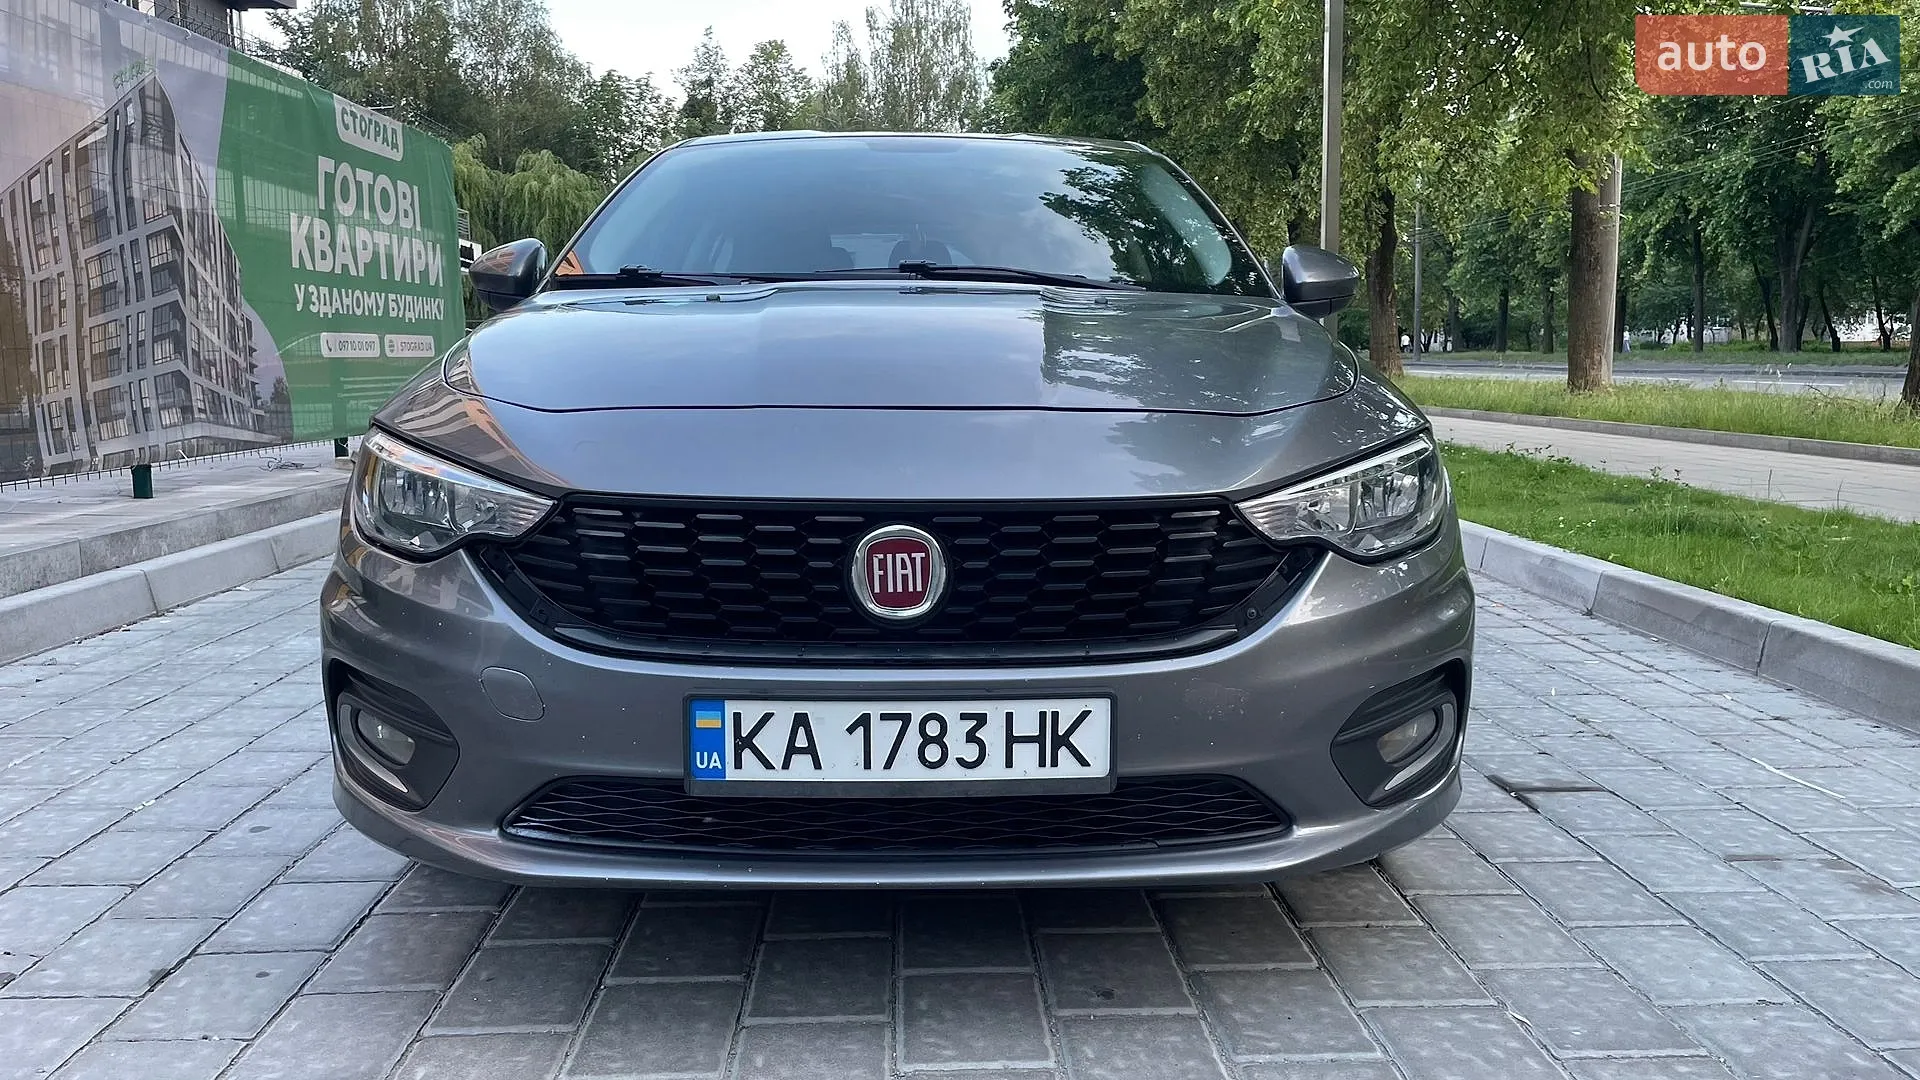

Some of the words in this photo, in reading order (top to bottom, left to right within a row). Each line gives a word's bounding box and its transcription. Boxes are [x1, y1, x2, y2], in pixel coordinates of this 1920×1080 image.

[341, 106, 400, 153] СТОГРАД
[318, 156, 421, 231] ГОТОВІ
[289, 212, 443, 287] КВАРТИРИ
[294, 283, 305, 312] У
[309, 284, 386, 319] ЗДАНОМУ
[388, 292, 445, 323] БУДИНКУ
[872, 552, 926, 594] FIAT
[696, 752, 723, 770] UA
[732, 711, 823, 771] KA
[845, 711, 989, 771] 1783
[1004, 708, 1093, 769] HK
